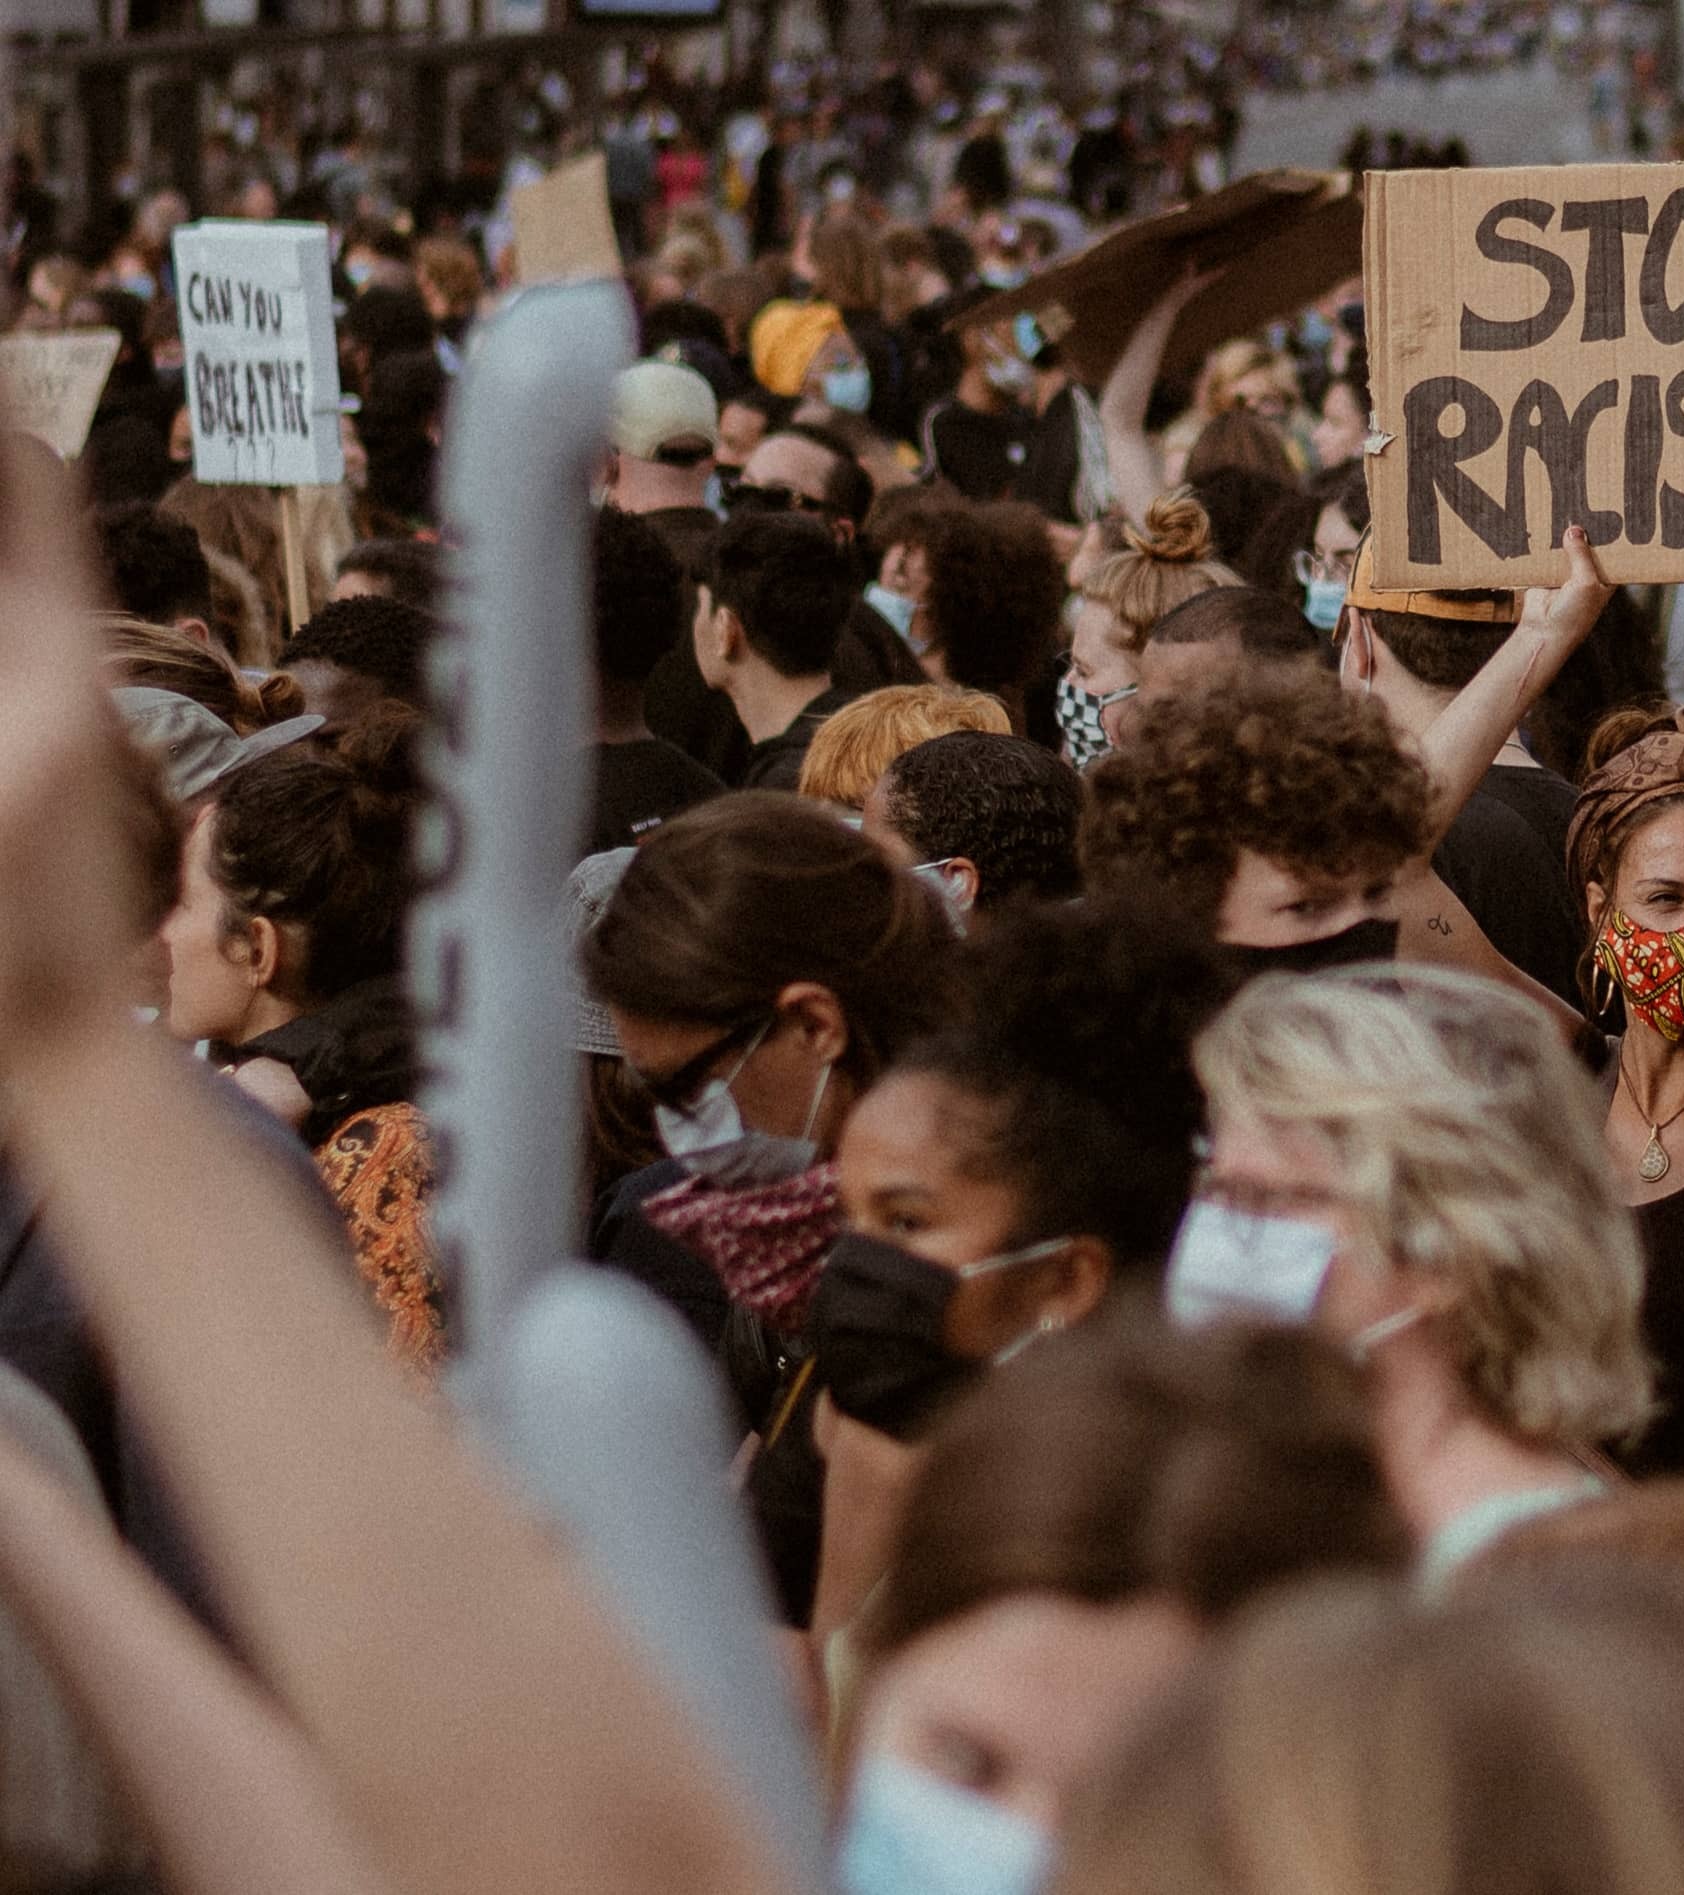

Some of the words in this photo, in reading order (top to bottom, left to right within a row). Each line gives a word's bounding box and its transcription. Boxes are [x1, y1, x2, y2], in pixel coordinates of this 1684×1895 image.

[187, 271, 235, 327] CAN
[238, 280, 284, 336] YOU
[195, 350, 310, 438] BREATHE
